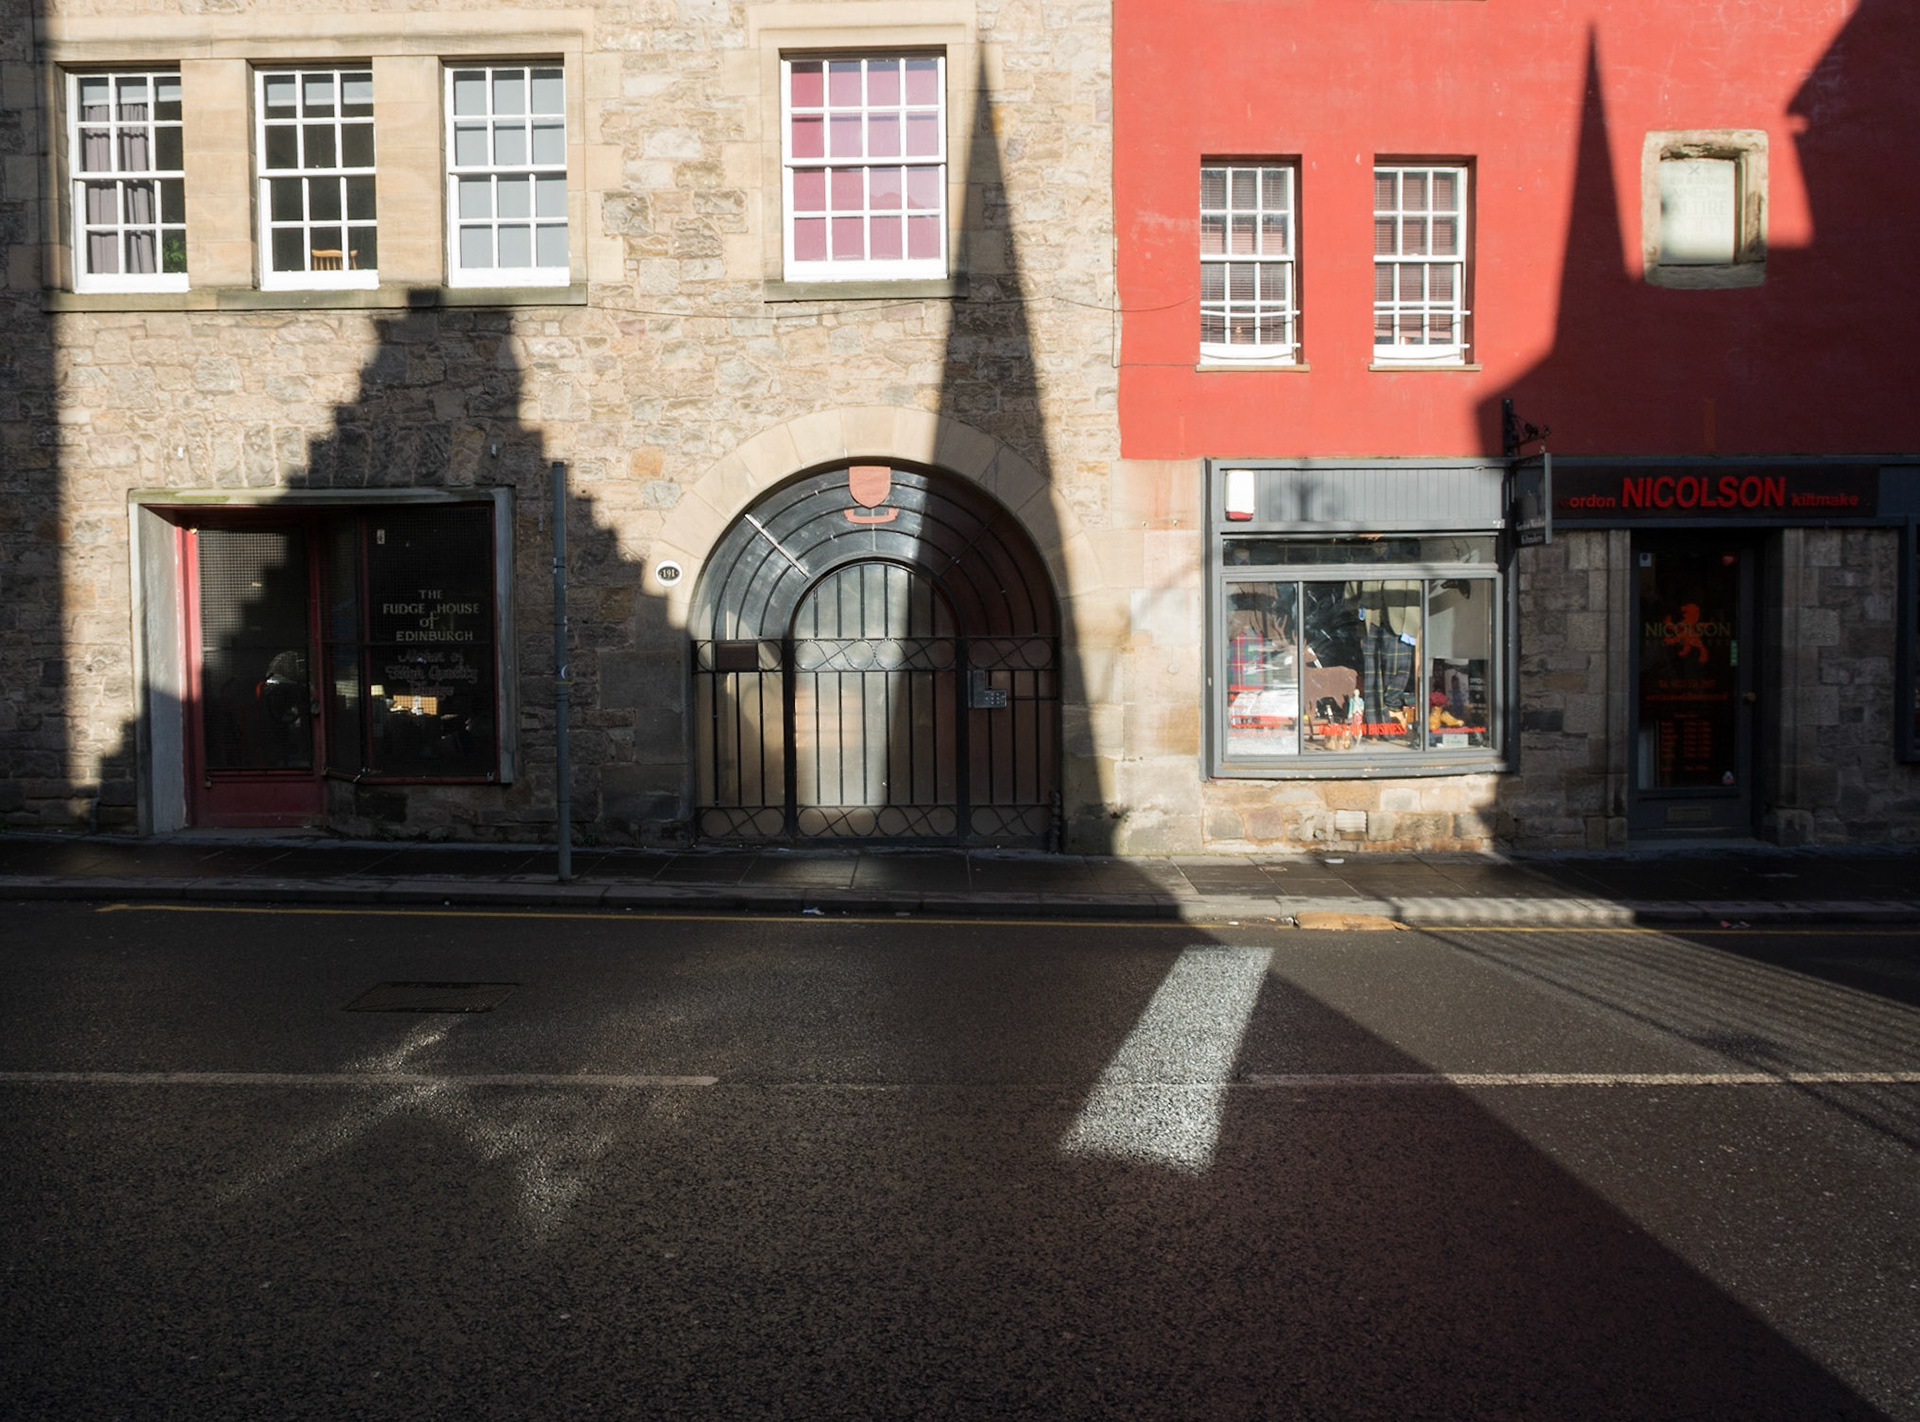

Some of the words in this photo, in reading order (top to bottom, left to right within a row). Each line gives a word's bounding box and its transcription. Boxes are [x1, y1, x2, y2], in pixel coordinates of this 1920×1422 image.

[1622, 476, 1785, 508] NICOLSON
[662, 568, 676, 578] 191
[418, 589, 443, 600] THE
[382, 603, 426, 615] FUDGE
[435, 603, 480, 614] HOUSE
[419, 611, 440, 630] of
[1644, 621, 1731, 638] NICOLSON
[395, 630, 474, 642] EDINBURGH
